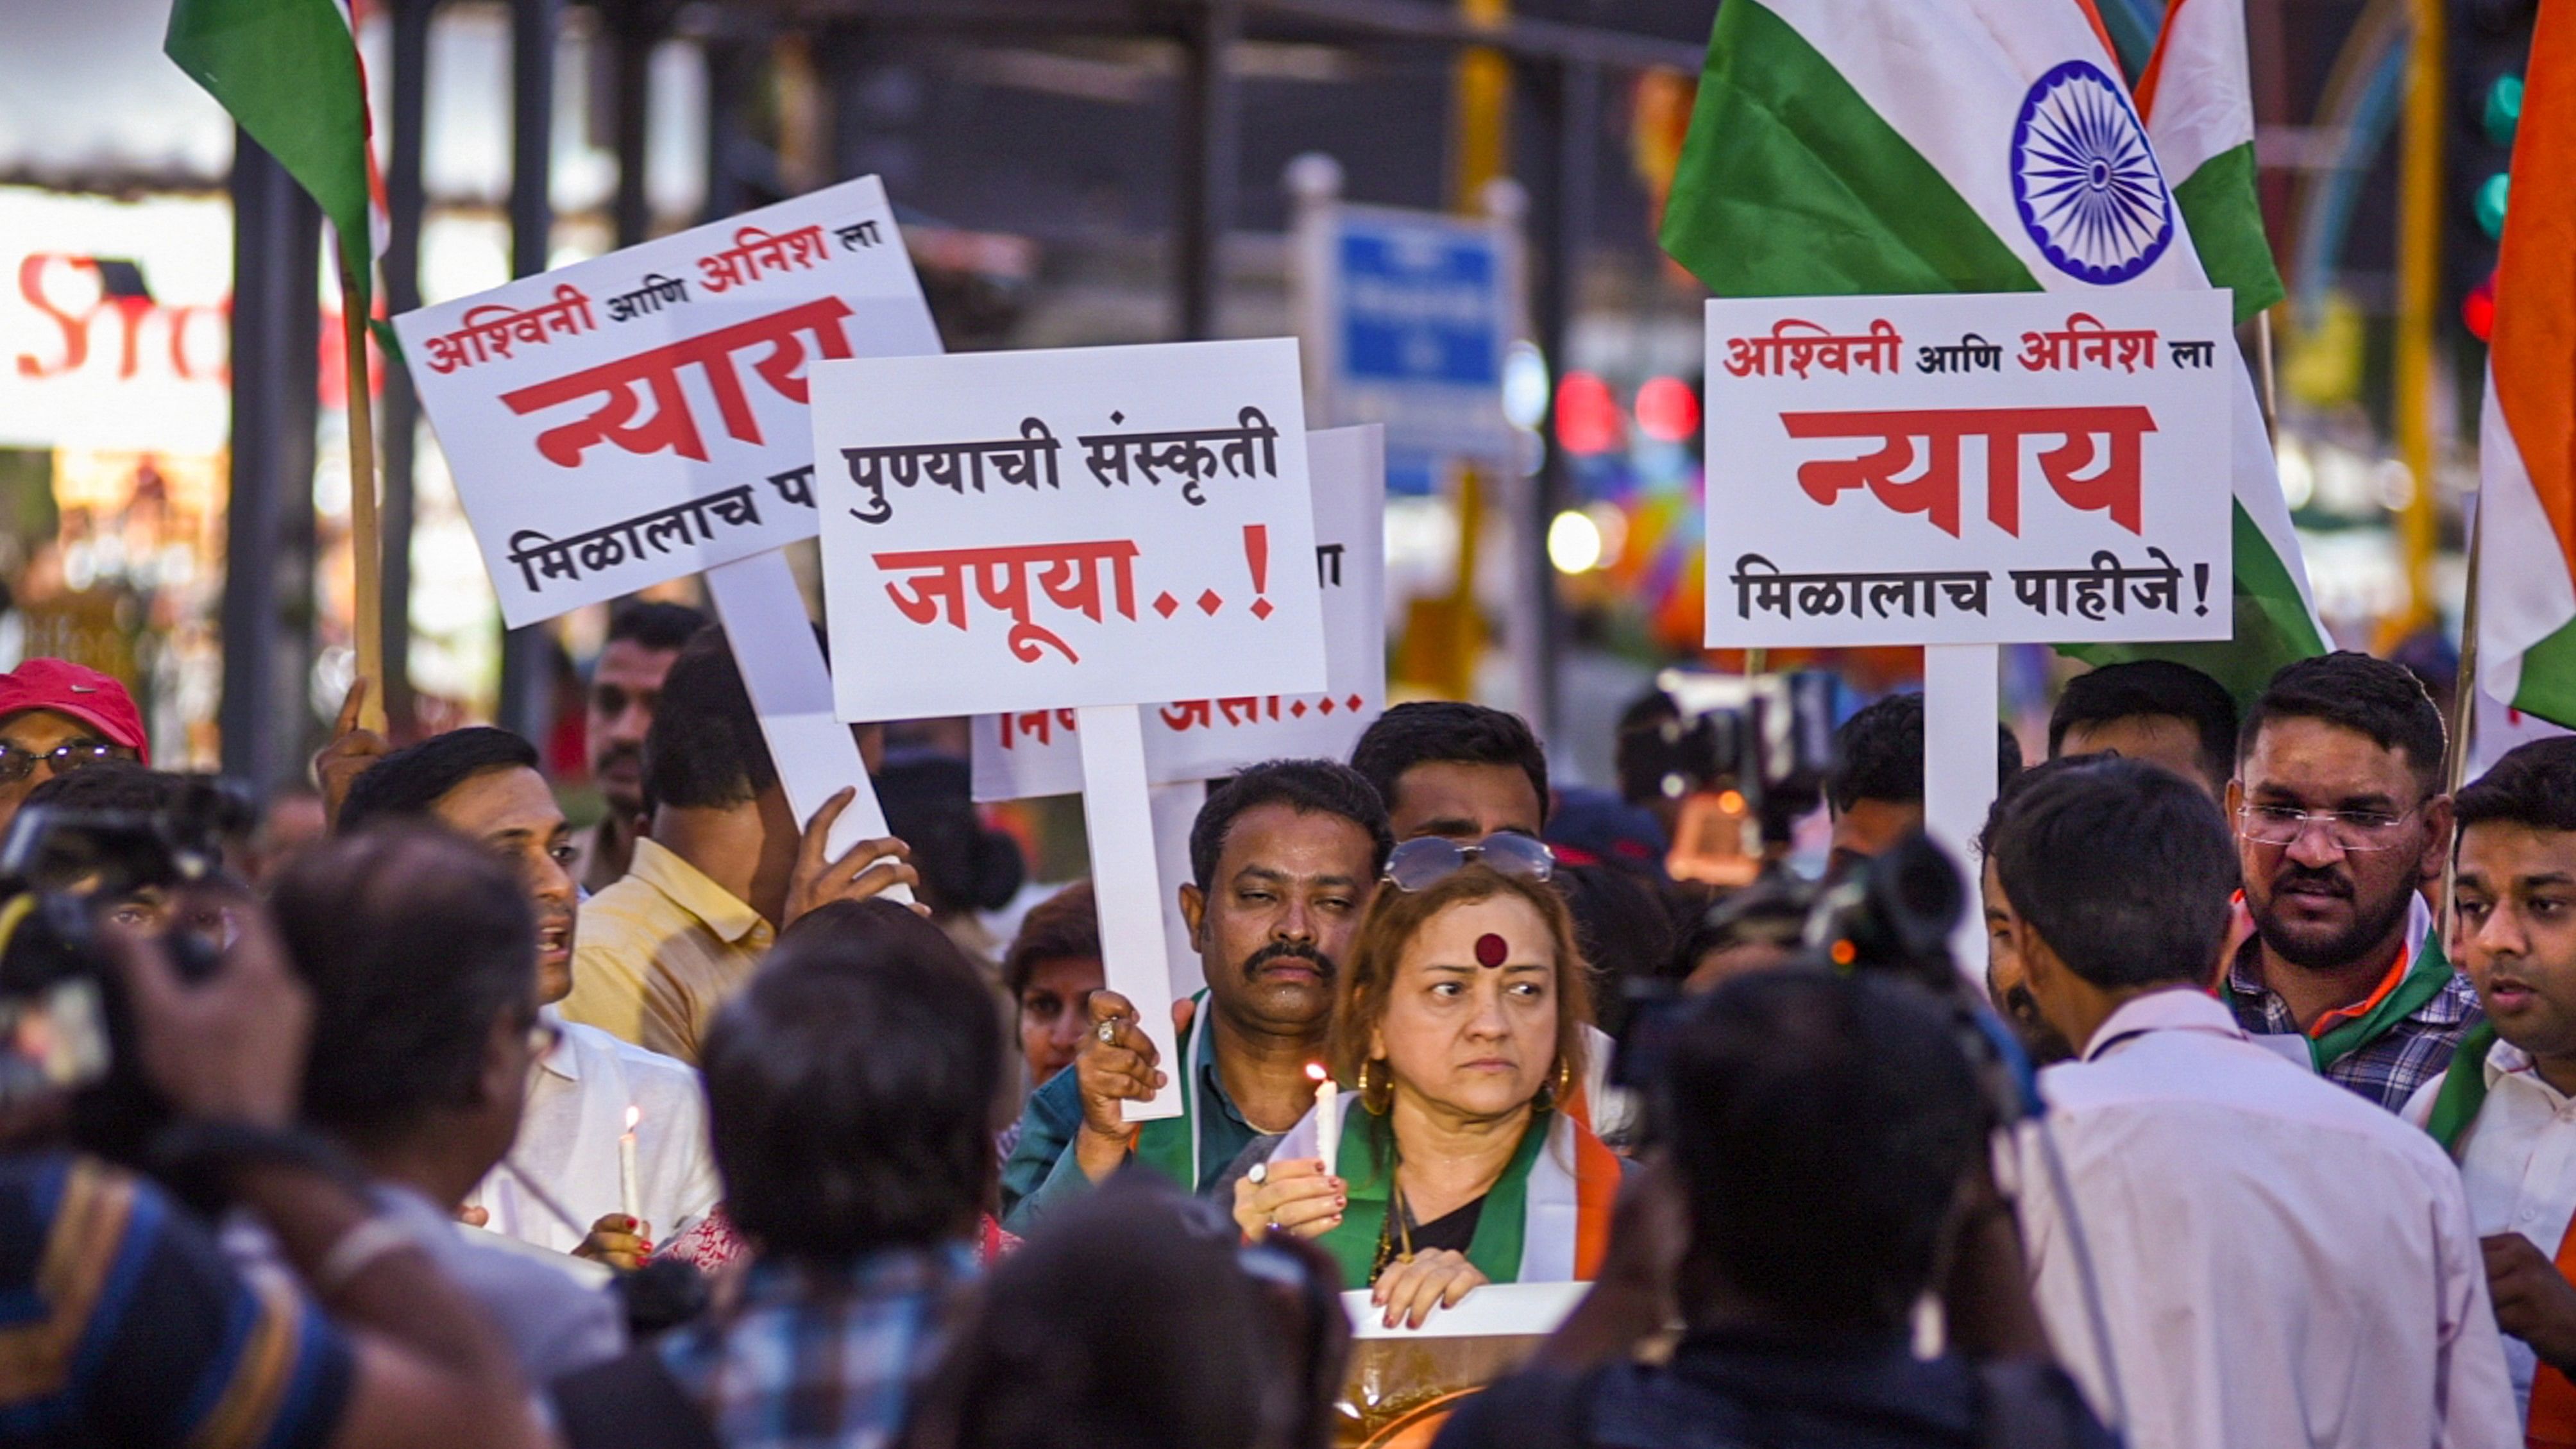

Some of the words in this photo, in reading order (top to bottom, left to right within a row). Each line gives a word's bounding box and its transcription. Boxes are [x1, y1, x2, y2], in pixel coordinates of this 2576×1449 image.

[426, 284, 594, 375] अश्विनी
[608, 274, 688, 322] आणि
[697, 225, 829, 293] अनिश
[835, 221, 879, 251] ला
[1724, 318, 1903, 378] अश्विनी
[1916, 333, 2003, 374] आणि
[2018, 312, 2159, 373] अनिश
[2168, 341, 2215, 369] ला
[500, 296, 854, 468] न्याय
[841, 417, 1061, 524] पुण्याची
[1078, 406, 1278, 505] संस्कृती
[1780, 405, 2158, 538] न्याय
[508, 484, 761, 592] मिळालाच
[1729, 554, 1992, 620] मिळालाच
